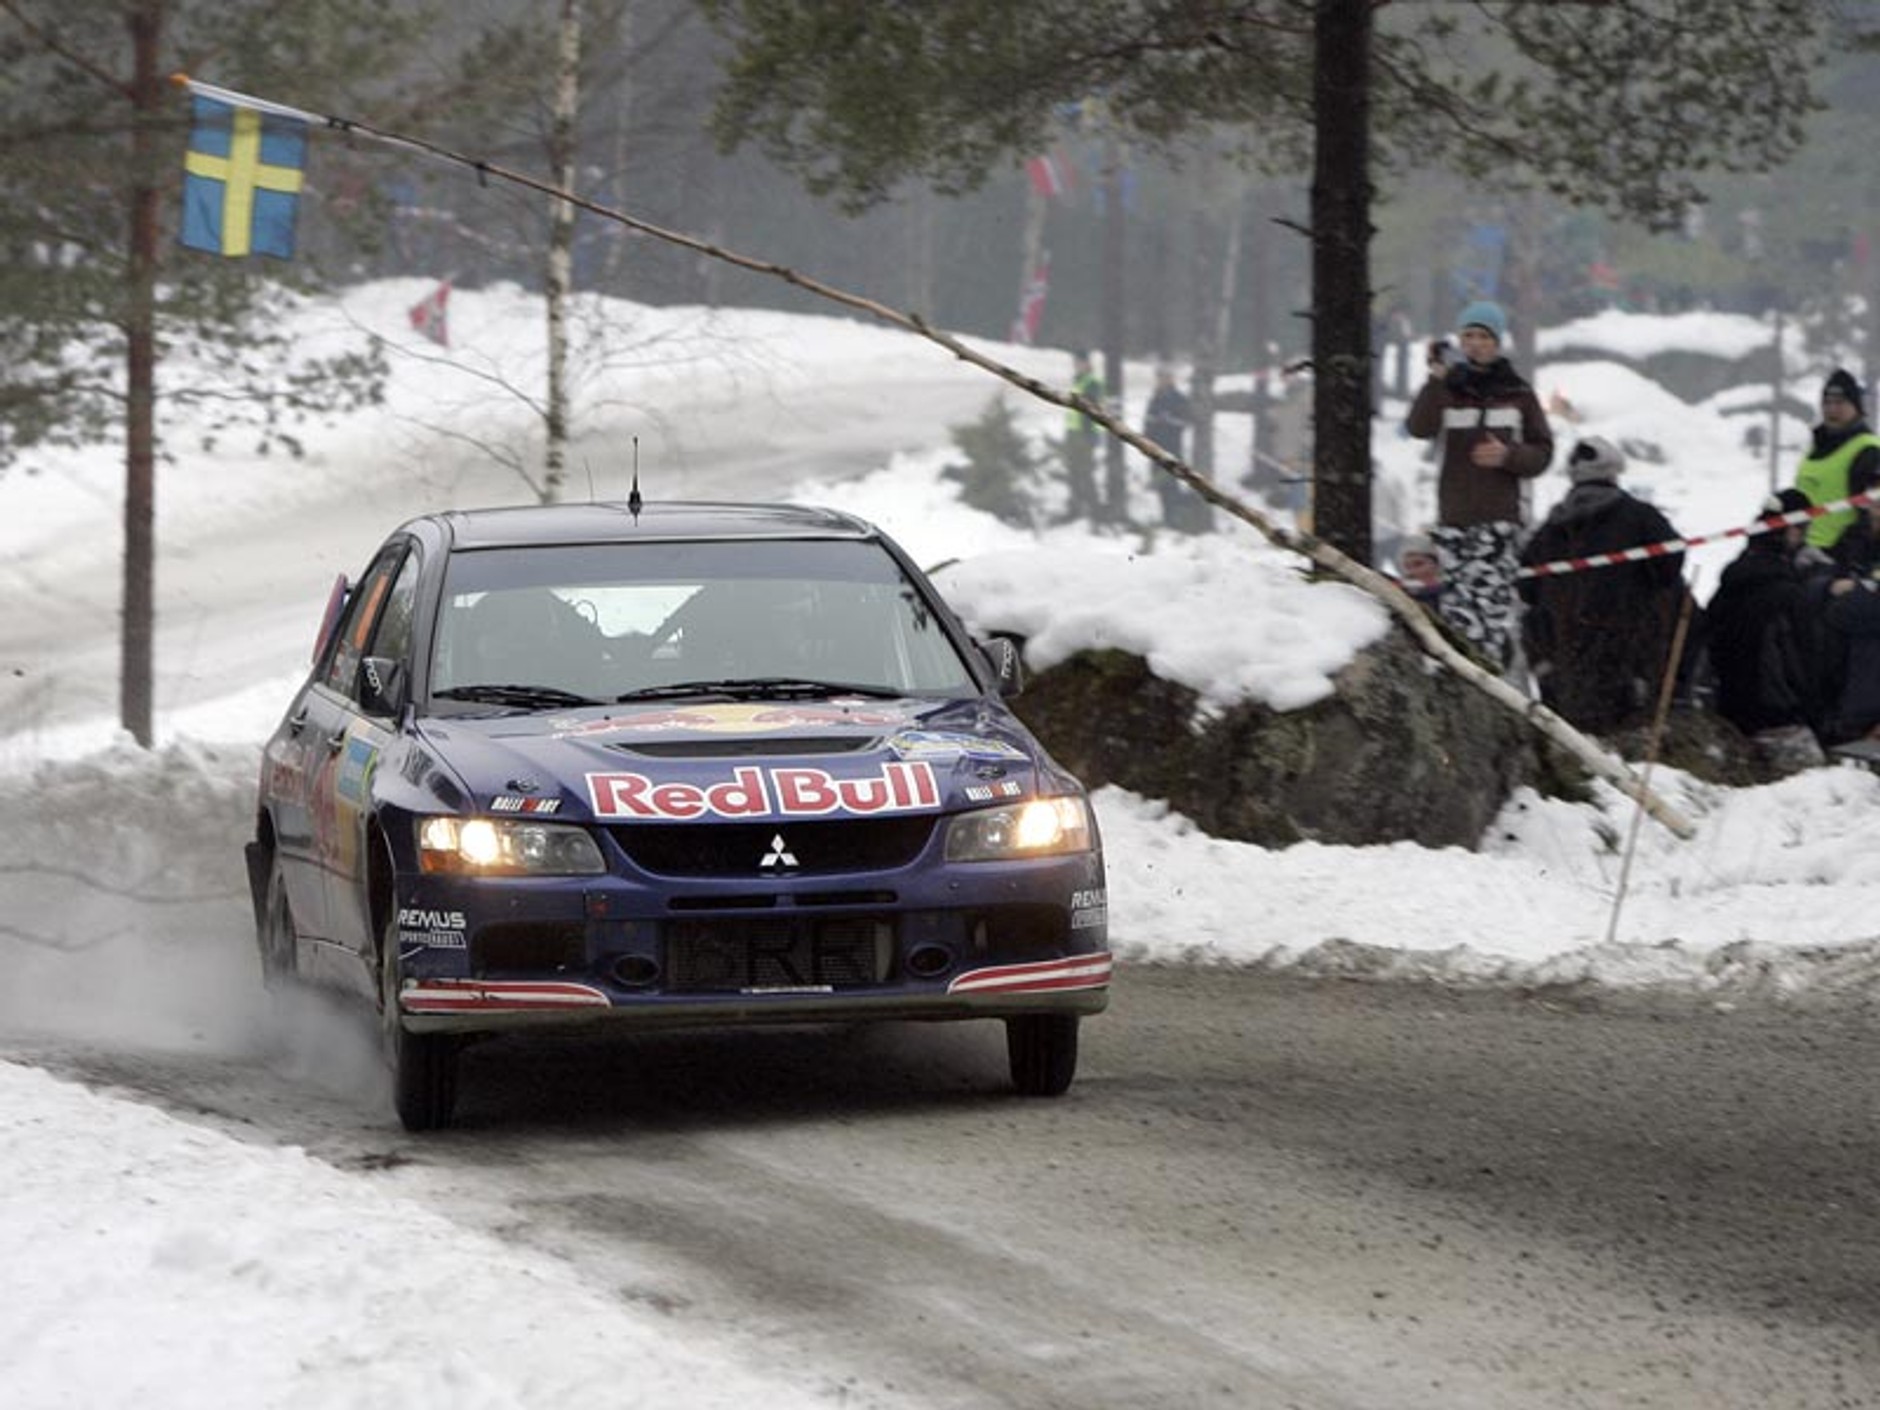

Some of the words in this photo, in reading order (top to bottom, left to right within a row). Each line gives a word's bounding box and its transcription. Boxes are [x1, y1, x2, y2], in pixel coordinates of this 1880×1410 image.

[587, 767, 770, 818] Red
[772, 762, 940, 815] Bull
[398, 908, 466, 929] REMUS
